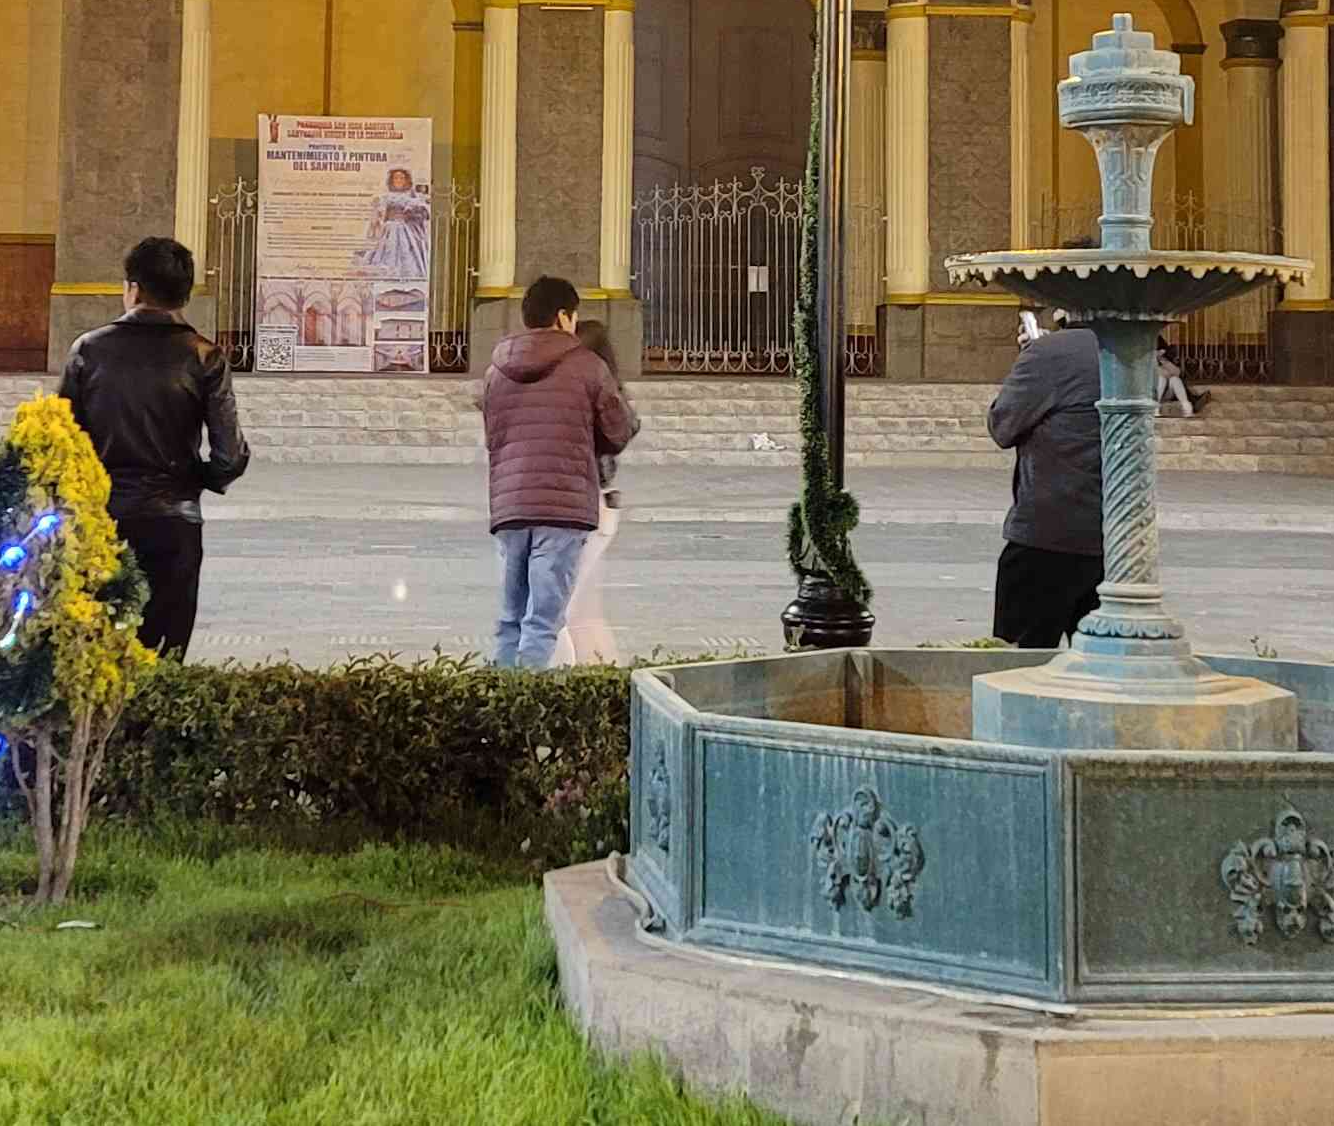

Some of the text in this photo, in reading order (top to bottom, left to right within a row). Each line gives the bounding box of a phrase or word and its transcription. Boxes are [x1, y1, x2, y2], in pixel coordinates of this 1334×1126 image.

[267, 151, 388, 163] MANTENIMIENTO Y PINTURA
[293, 162, 361, 172] DEL SANTUARIO
